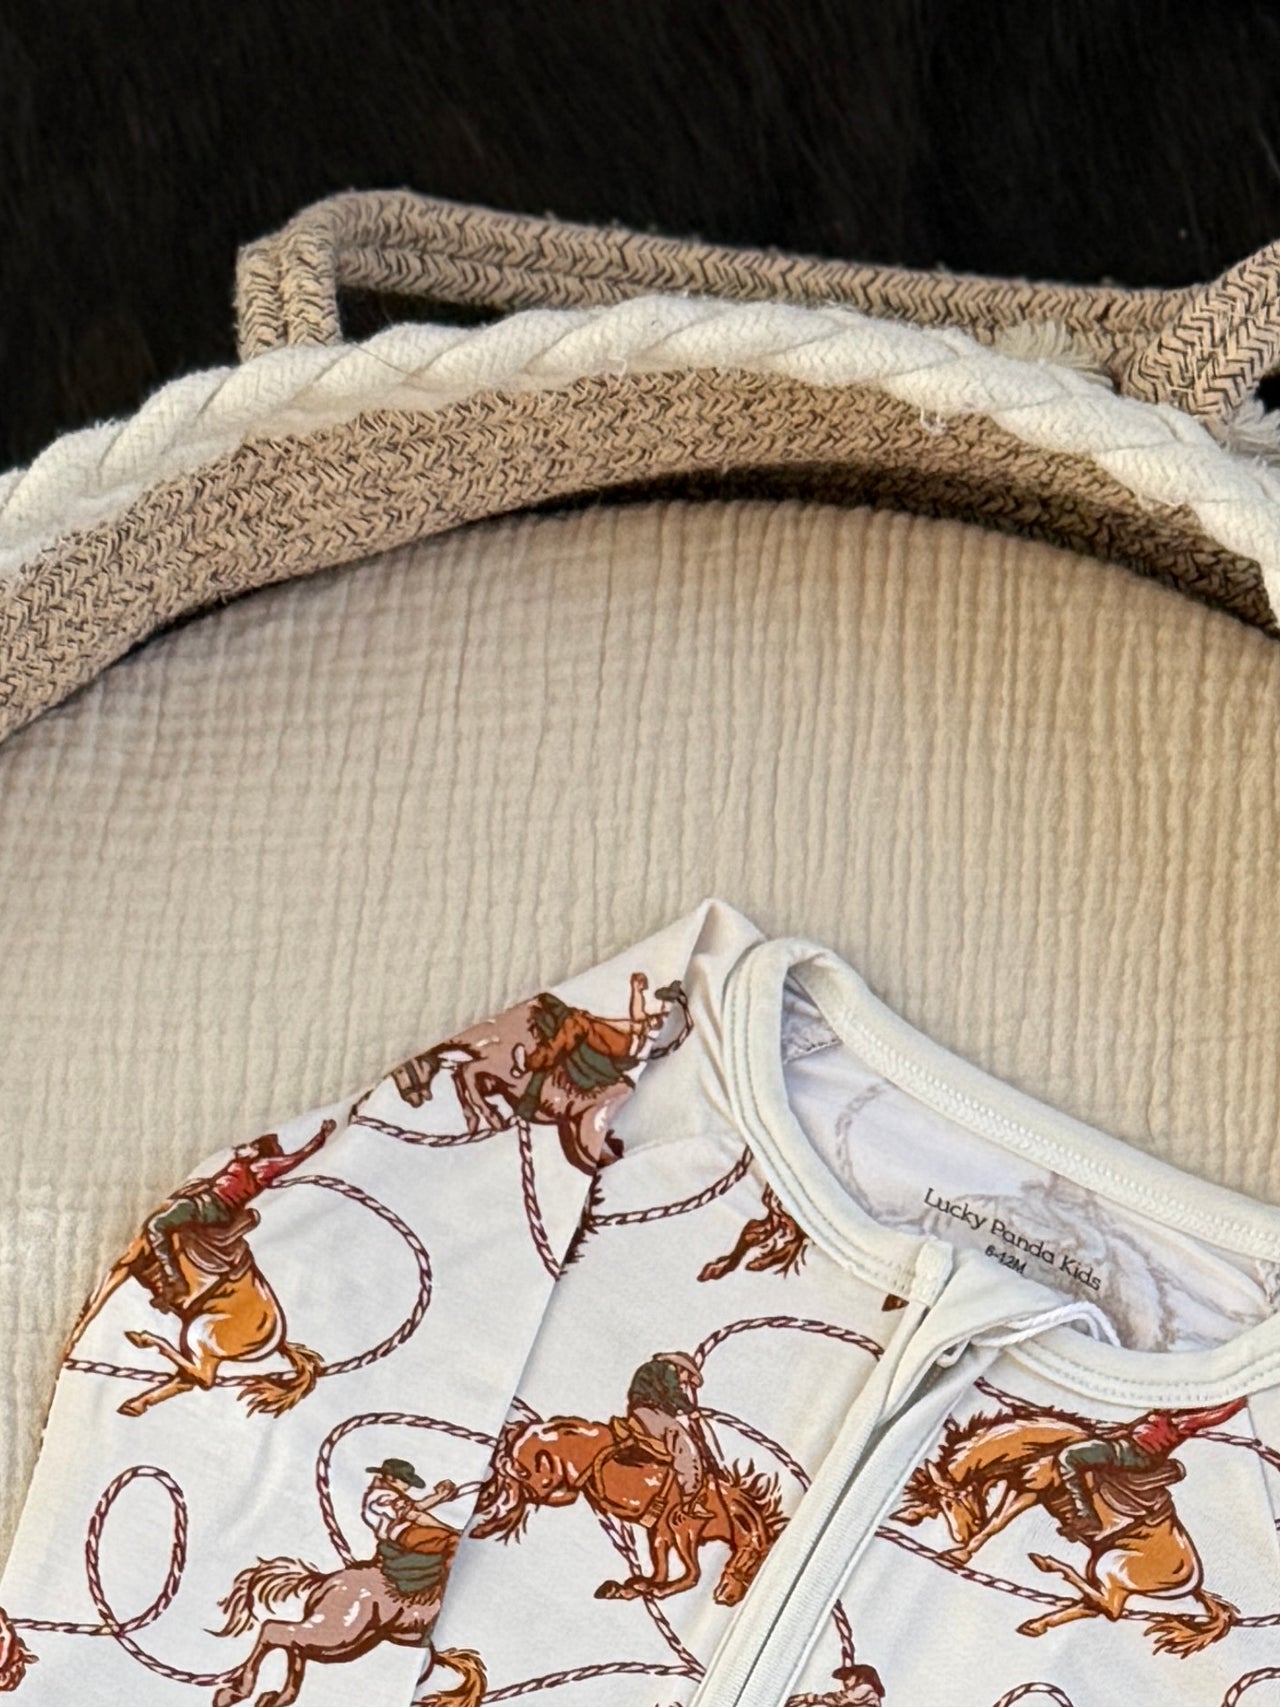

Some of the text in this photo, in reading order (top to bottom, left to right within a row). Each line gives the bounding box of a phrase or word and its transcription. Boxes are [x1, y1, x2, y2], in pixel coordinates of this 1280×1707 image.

[925, 1188, 1101, 1291] Lucky Panda Kids
[985, 1245, 1027, 1275] 6-12M
